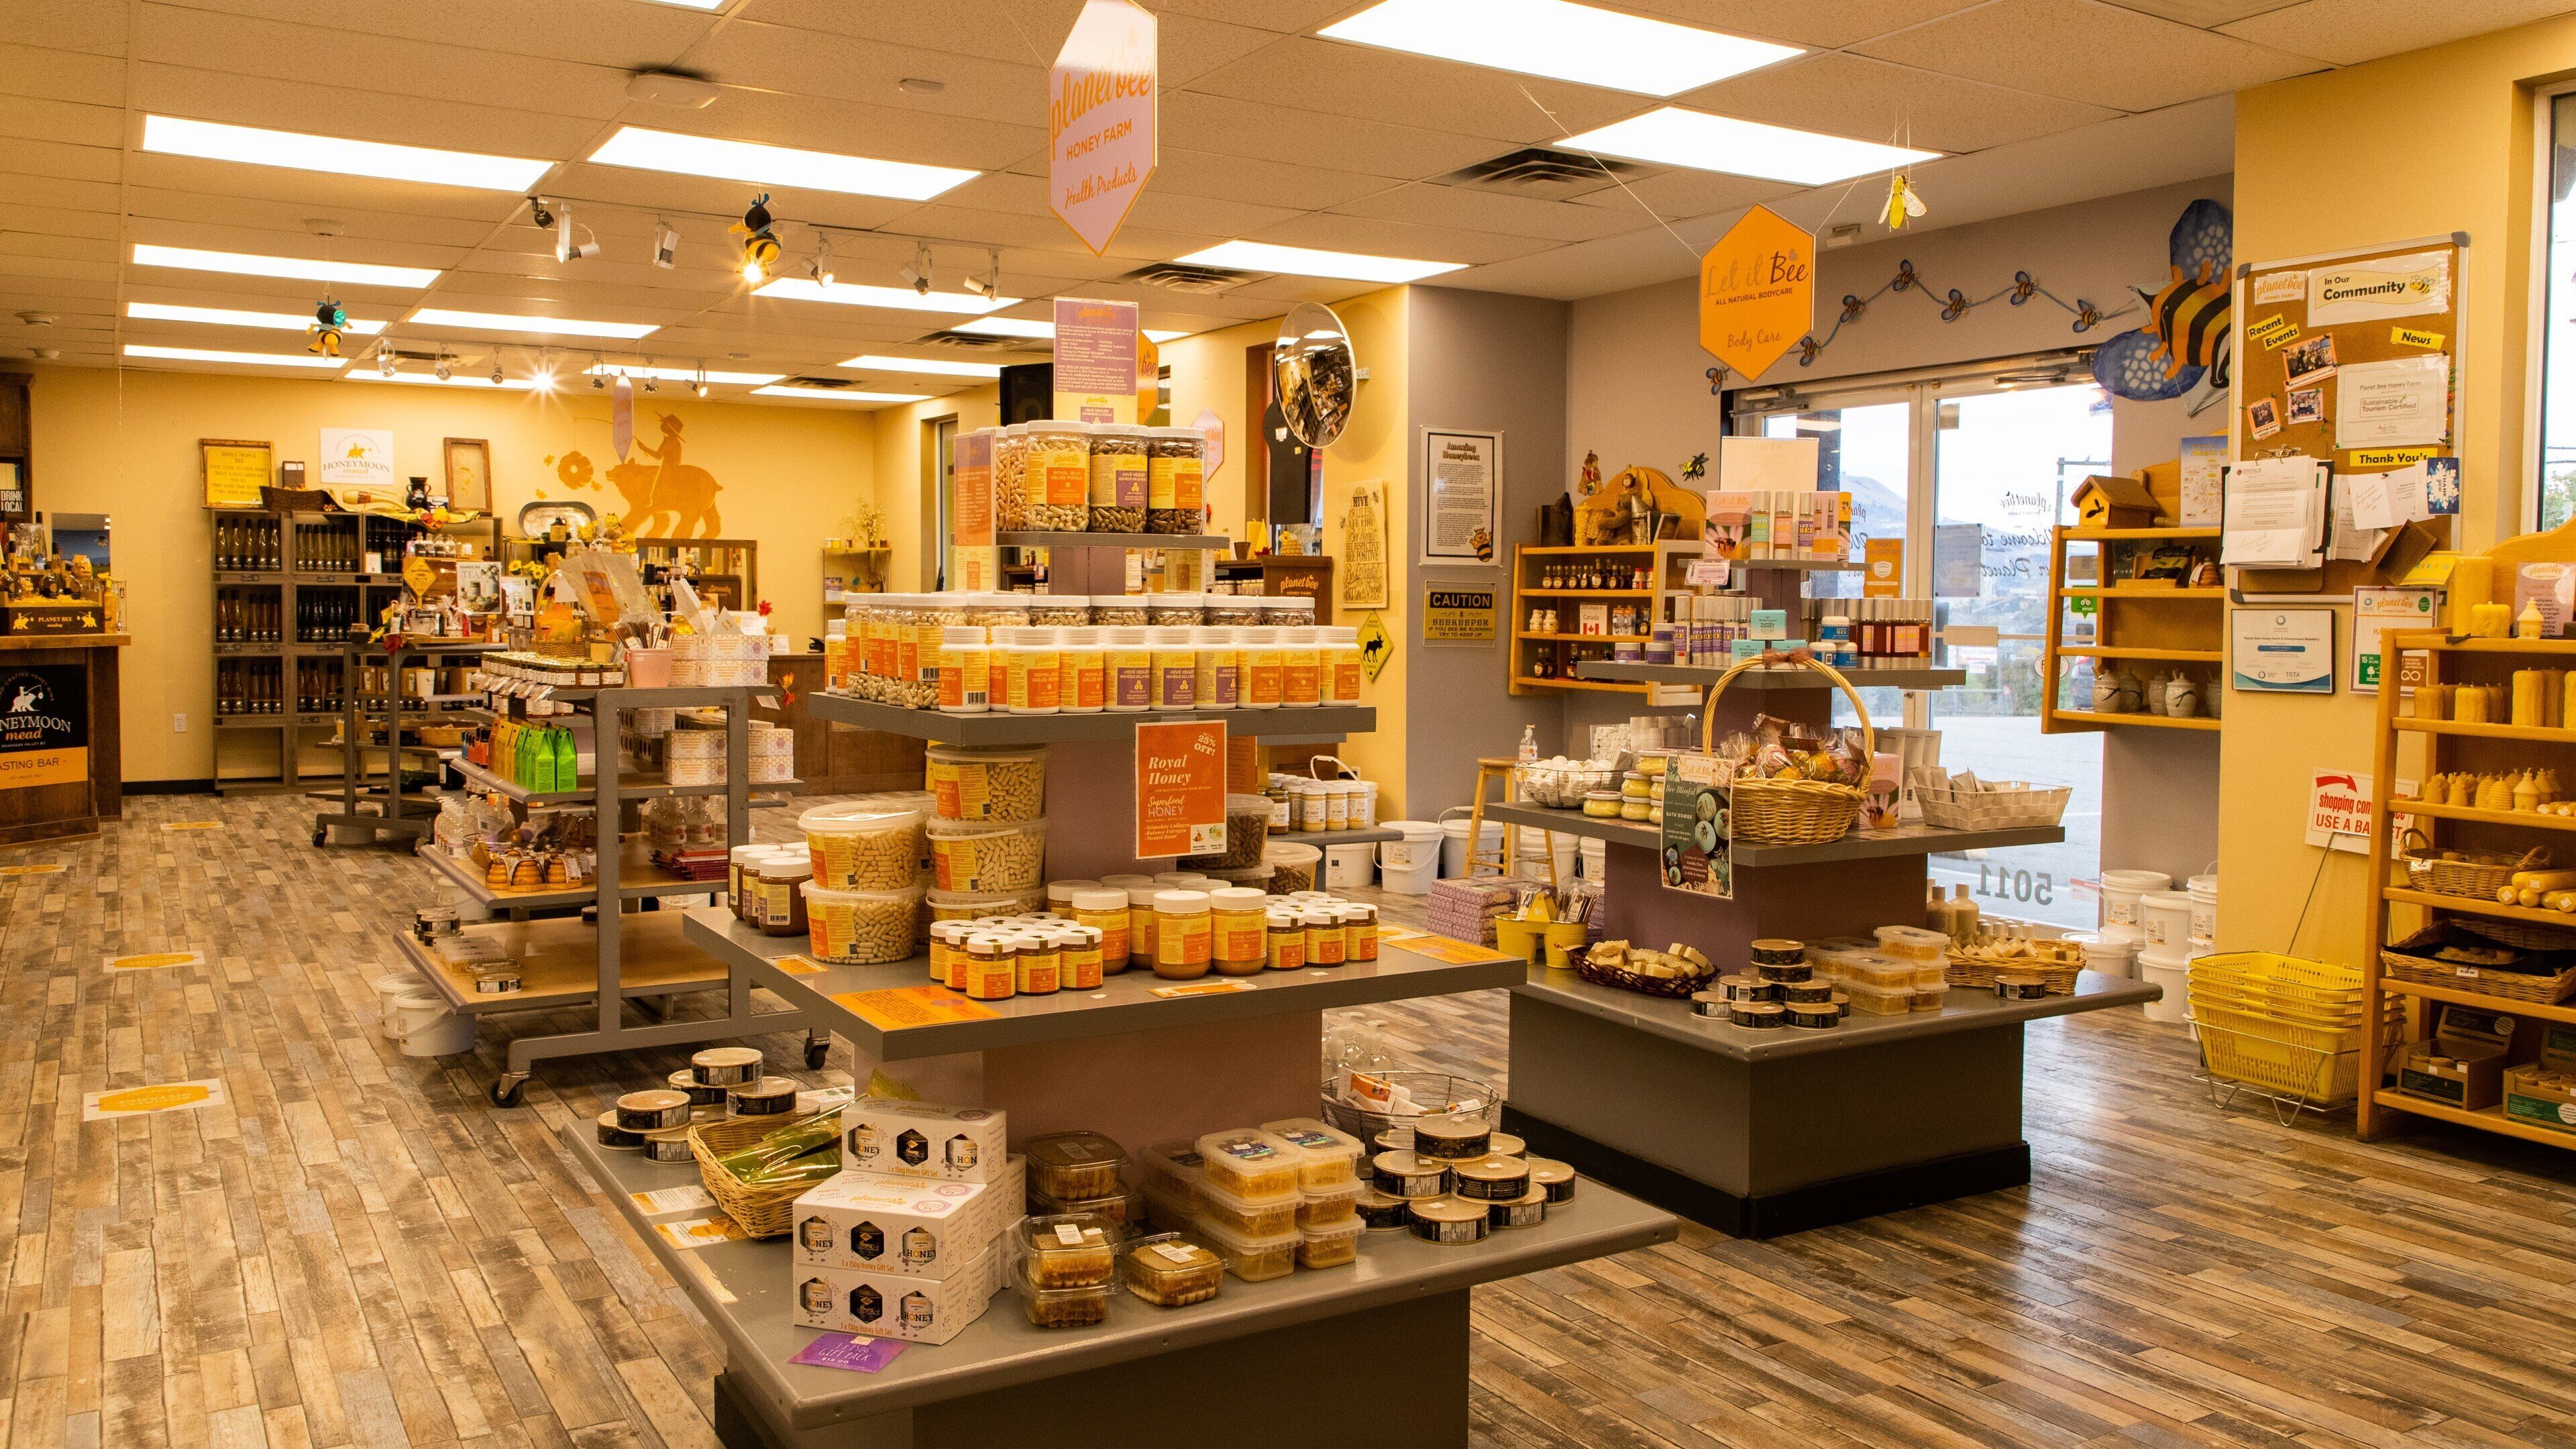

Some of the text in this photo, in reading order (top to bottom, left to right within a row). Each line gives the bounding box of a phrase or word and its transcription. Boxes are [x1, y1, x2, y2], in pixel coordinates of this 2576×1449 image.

[1066, 118, 1132, 162] HONEY FARM
[1064, 162, 1138, 210] Health Products
[1705, 259, 1741, 297] Let
[1770, 249, 1809, 285] Bee
[2257, 275, 2304, 300] planetbee
[2324, 276, 2350, 286] In Our
[1728, 293, 1757, 304] NATURAL
[1758, 287, 1793, 299] BODYCARE
[2323, 281, 2406, 301] Community
[2249, 317, 2283, 337] Recent
[1727, 328, 1782, 352] Body Care
[2265, 326, 2298, 347] Events
[2402, 332, 2431, 345] News
[2388, 402, 2416, 411] Certified
[1446, 442, 1477, 453] Amazing
[1442, 451, 1480, 462] Honeybees
[2359, 453, 2395, 465] Thank
[323, 460, 390, 473] HONEYMOON
[1, 490, 23, 502] DRINK
[1353, 496, 1368, 507] HIVE
[1351, 508, 1371, 518] RULES
[1354, 541, 1379, 550] RESPECTFUL
[1346, 549, 1379, 562] BEE POSITIVE
[463, 571, 480, 579] TEA
[1281, 575, 1319, 594] planetbee
[1433, 594, 1491, 608] CAUTION
[1432, 619, 1489, 627] BEEKEEPER
[0, 716, 71, 733] NEYMOON
[5, 727, 43, 741] mead
[1198, 735, 1216, 747] 25%
[1194, 743, 1215, 756] OFF!
[0, 757, 59, 771] ASTING BAR
[1148, 755, 1188, 771] Royal
[1148, 772, 1191, 786] Honey
[1666, 784, 1697, 797] Bee Blissful
[1148, 796, 1185, 809] Superfood
[2319, 792, 2355, 814] shopping
[1148, 806, 1183, 817] HONEY
[2316, 813, 2340, 829] USE
[2343, 818, 2351, 831] A
[856, 1143, 880, 1154] HONEY
[895, 1166, 905, 1175] 150g
[906, 1167, 920, 1177] Honey
[806, 1238, 833, 1248] HONEY
[907, 1248, 936, 1259] HONEY
[849, 1260, 860, 1269] 150g
[861, 1263, 875, 1272] Honey
[877, 1264, 885, 1272] Gift
[808, 1298, 833, 1309] HONEY
[905, 1311, 933, 1322] HONEY
[848, 1324, 859, 1332] 150g
[859, 1325, 873, 1334] Honey
[875, 1326, 883, 1334] Gift
[818, 1348, 872, 1362] GIFT PACK
[848, 1345, 869, 1353] 150G
